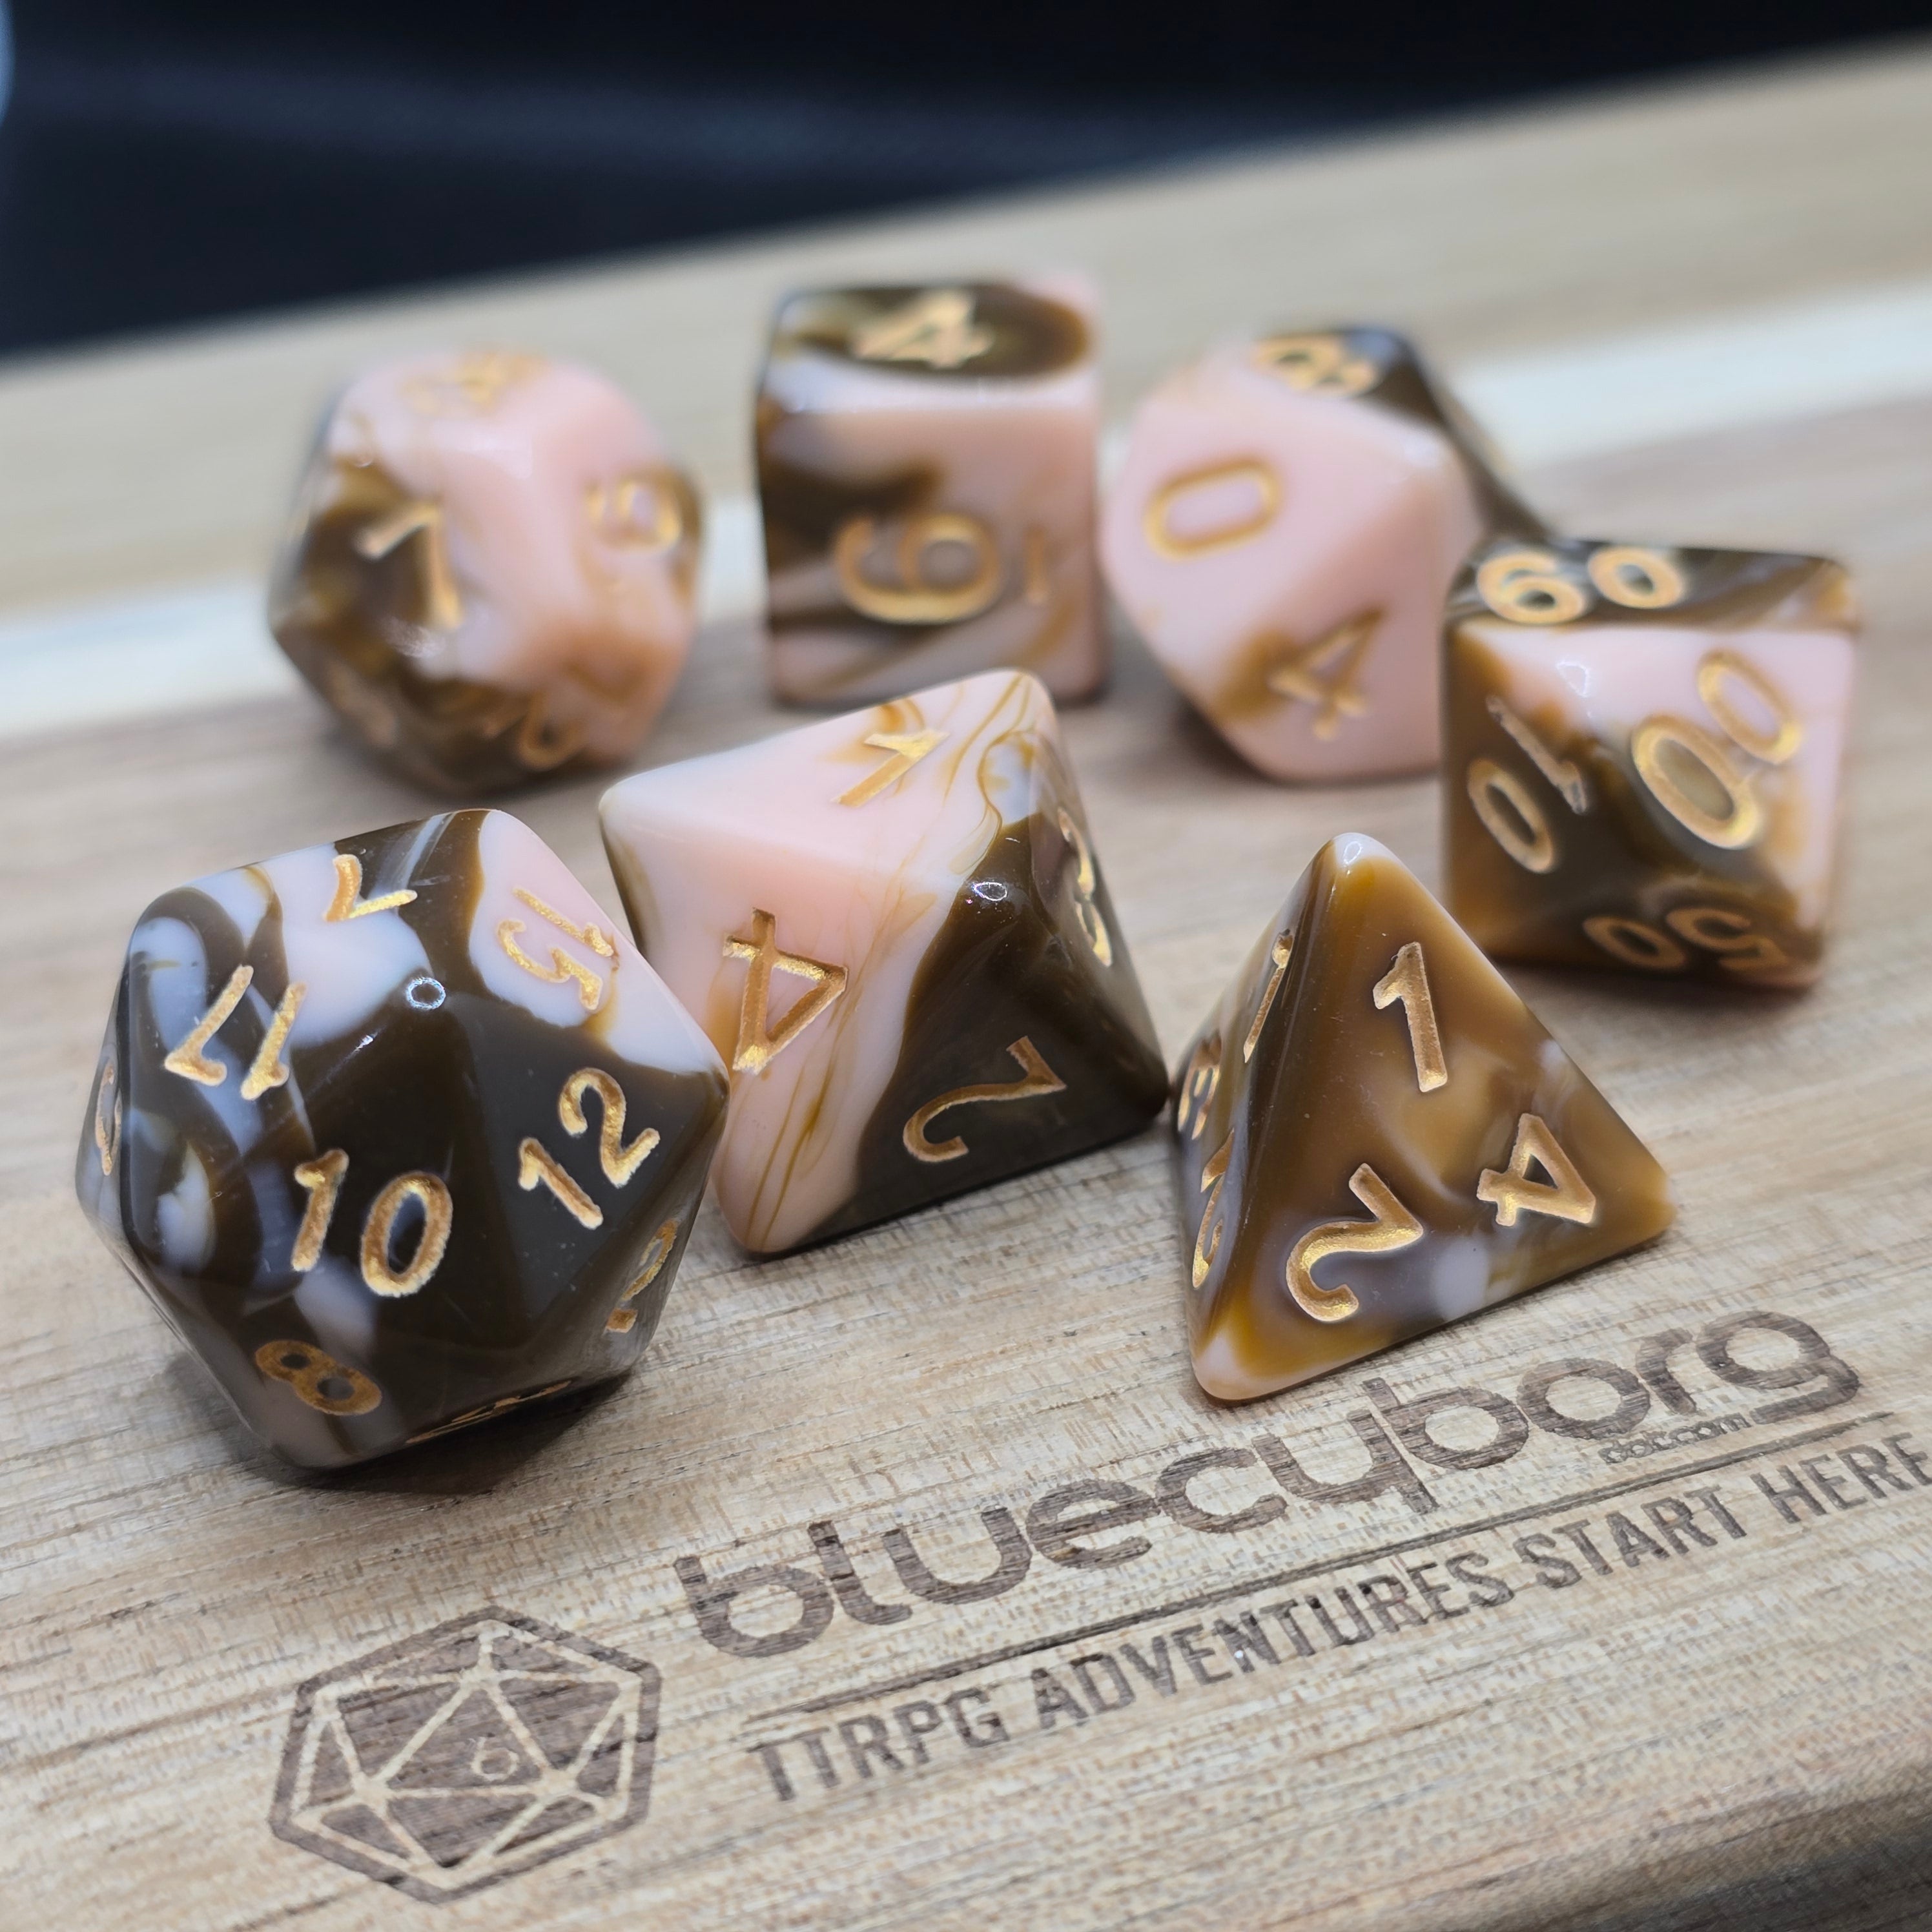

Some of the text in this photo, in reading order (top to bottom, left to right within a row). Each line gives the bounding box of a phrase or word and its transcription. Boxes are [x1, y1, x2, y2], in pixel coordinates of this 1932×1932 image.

[849, 288, 995, 369] 4
[1144, 454, 1282, 563] 0
[1477, 546, 1686, 624] 60
[1268, 605, 1388, 741] 4
[1631, 647, 1801, 851] 00
[497, 889, 615, 1010] 15
[723, 908, 848, 1074] 4
[1373, 941, 1448, 1093] 1
[519, 1067, 661, 1229] 12
[904, 1035, 1067, 1162] 2
[1476, 1112, 1597, 1227] 4
[291, 1148, 453, 1298] 10
[1286, 1162, 1424, 1323] 2
[254, 1339, 382, 1416] 8
[673, 1310, 1860, 1658] bluecyborg
[746, 1432, 1932, 1802] TTRPG ADVENTURES START HERE
